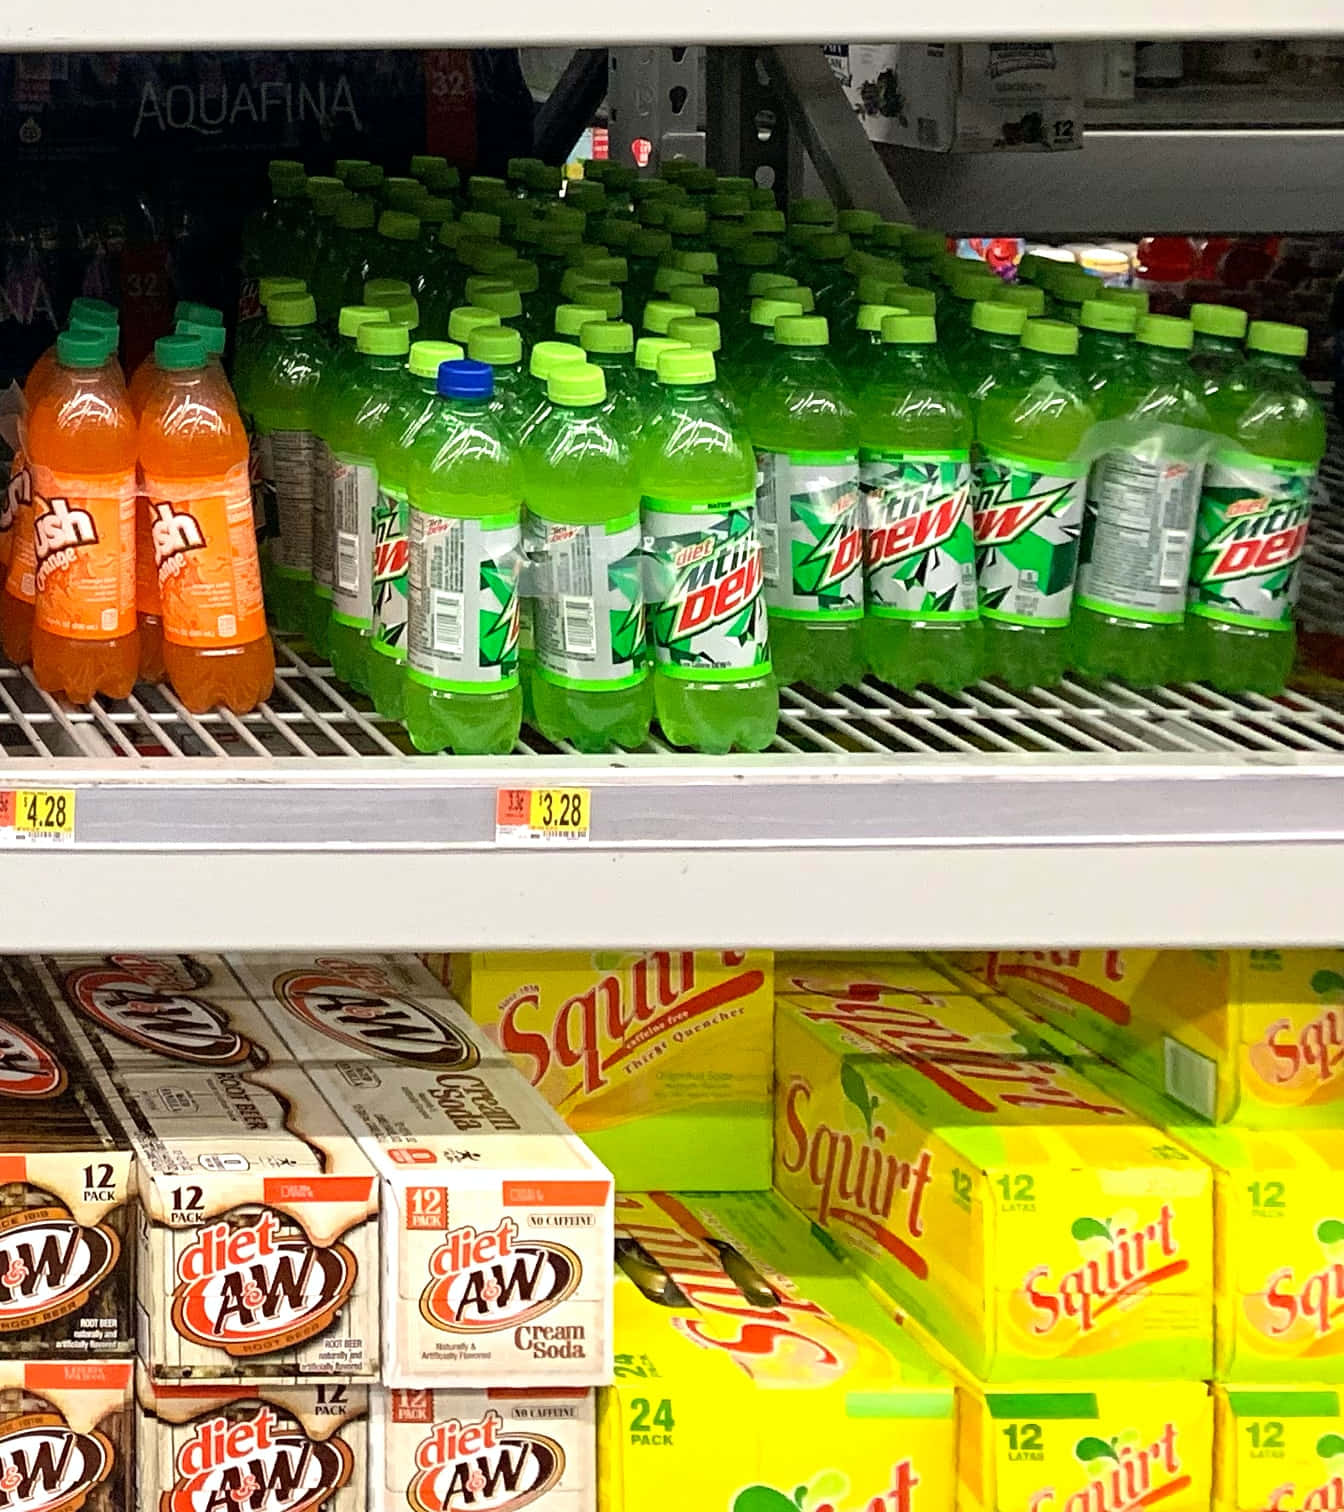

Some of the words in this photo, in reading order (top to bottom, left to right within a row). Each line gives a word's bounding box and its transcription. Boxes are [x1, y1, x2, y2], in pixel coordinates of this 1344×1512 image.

[134, 81, 362, 137] AQUAFINA
[677, 538, 713, 568] diet
[678, 548, 764, 634] DEW
[623, 1042, 670, 1075] Thirst
[673, 1006, 746, 1043] Quencher
[83, 1164, 116, 1190] 12
[783, 1079, 933, 1238] Squirt
[83, 1191, 116, 1201] PACK
[998, 1174, 1036, 1201] 12
[531, 1216, 543, 1226] NO
[546, 1215, 594, 1226] CAFFEINE
[182, 1210, 280, 1280] diet
[432, 1220, 513, 1278] diet
[215, 1247, 320, 1334] A&W
[455, 1252, 546, 1322] A&W
[1024, 1205, 1176, 1335] Squirt
[514, 1325, 586, 1352] Cream
[533, 1341, 586, 1360] Soda
[630, 1399, 675, 1433] 24
[631, 1434, 673, 1446] PACK
